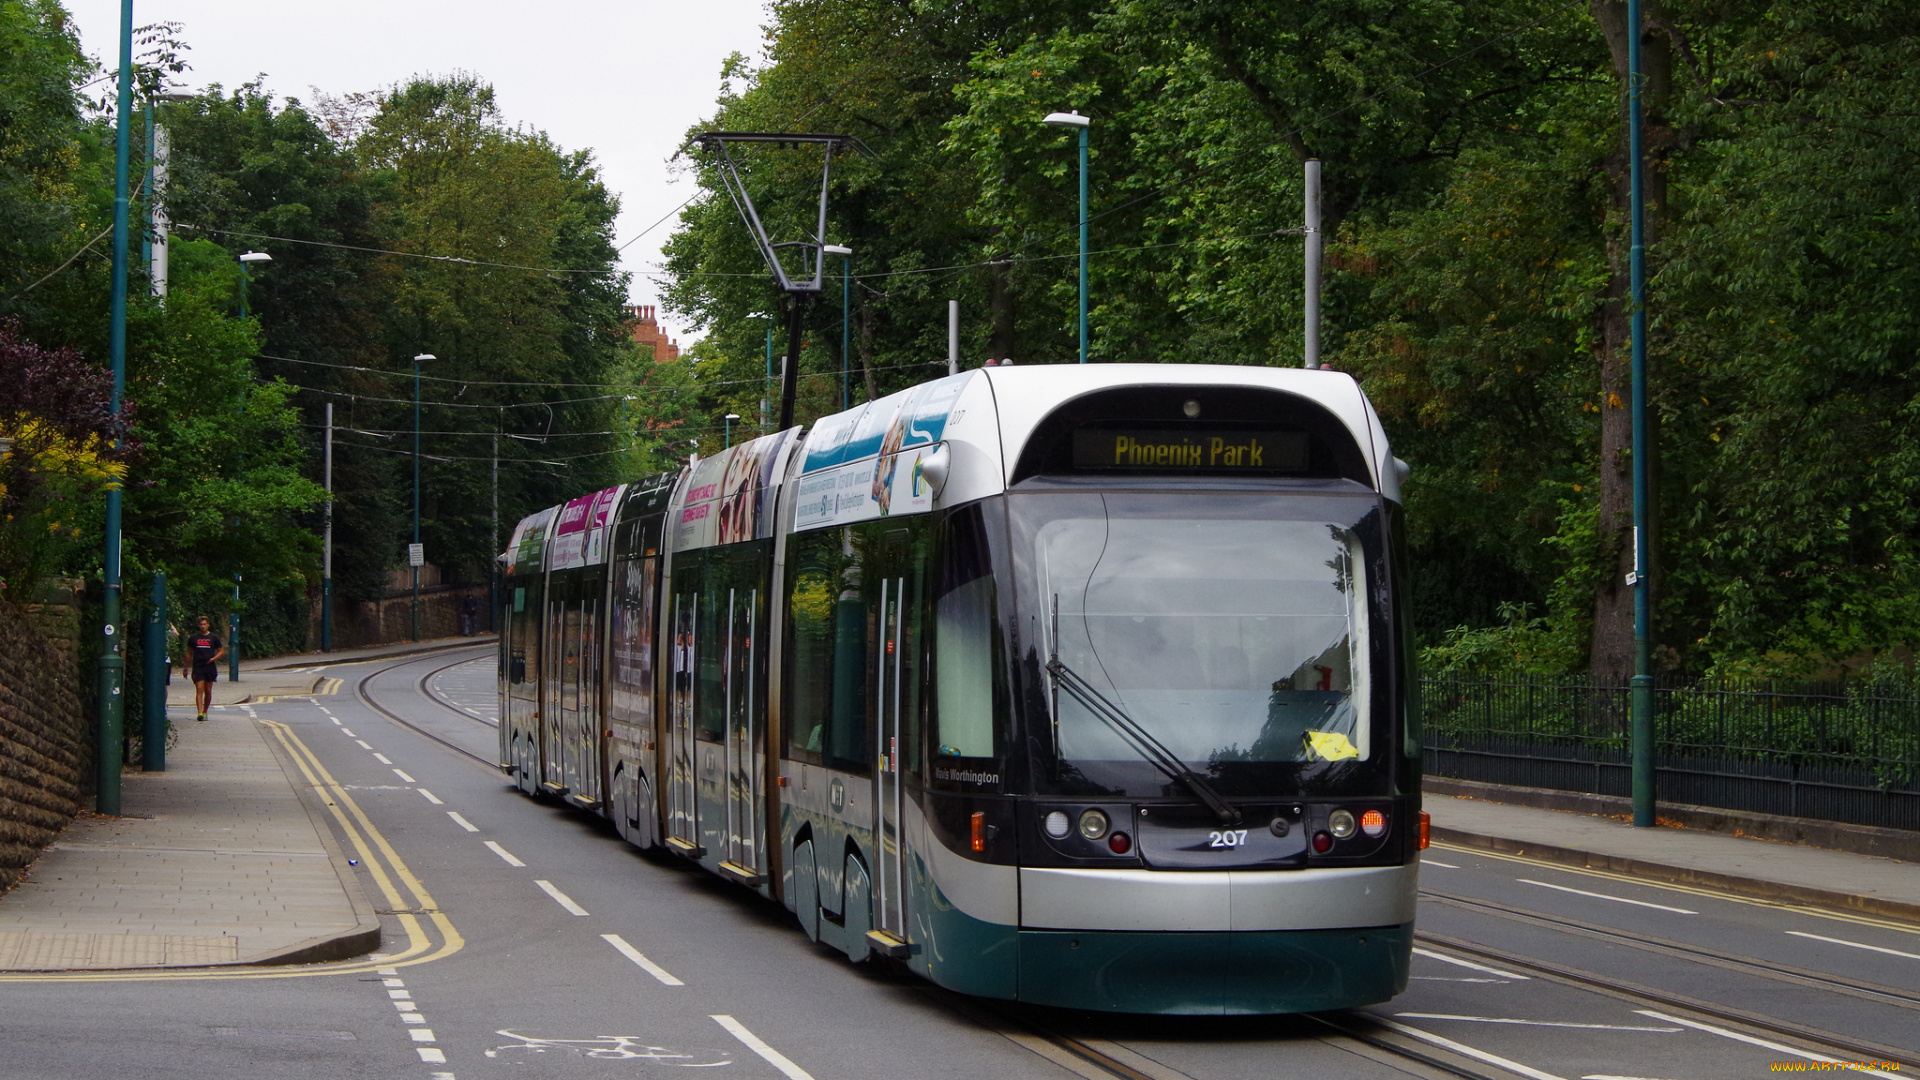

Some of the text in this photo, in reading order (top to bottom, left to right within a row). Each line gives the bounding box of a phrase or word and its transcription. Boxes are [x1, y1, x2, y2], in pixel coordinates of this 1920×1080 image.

[1115, 435, 1263, 467] Phoenix Park
[949, 767, 999, 786] Worthington
[1209, 829, 1248, 848] 207
